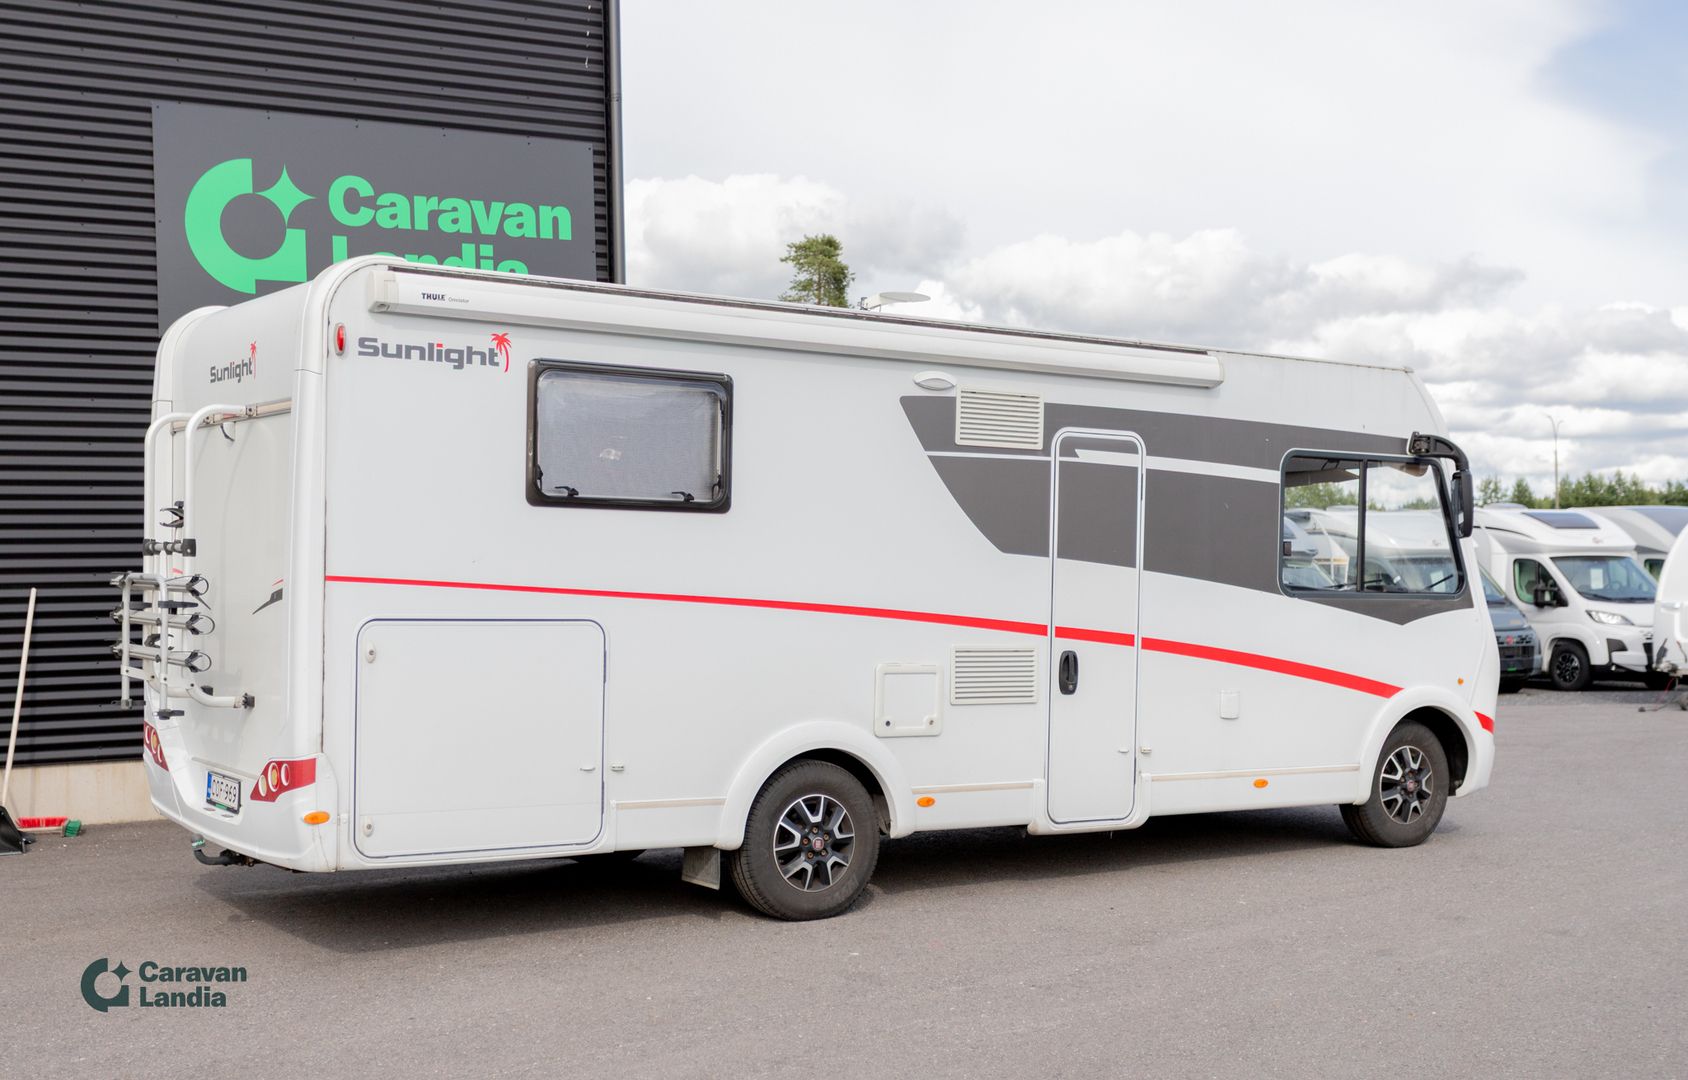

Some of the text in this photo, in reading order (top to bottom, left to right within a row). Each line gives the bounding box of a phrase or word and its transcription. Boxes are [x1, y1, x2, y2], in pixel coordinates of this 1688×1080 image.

[328, 175, 572, 241] Caravan
[421, 292, 446, 302] THULE
[358, 336, 500, 370] Sunlight
[209, 357, 253, 384] Sunlight
